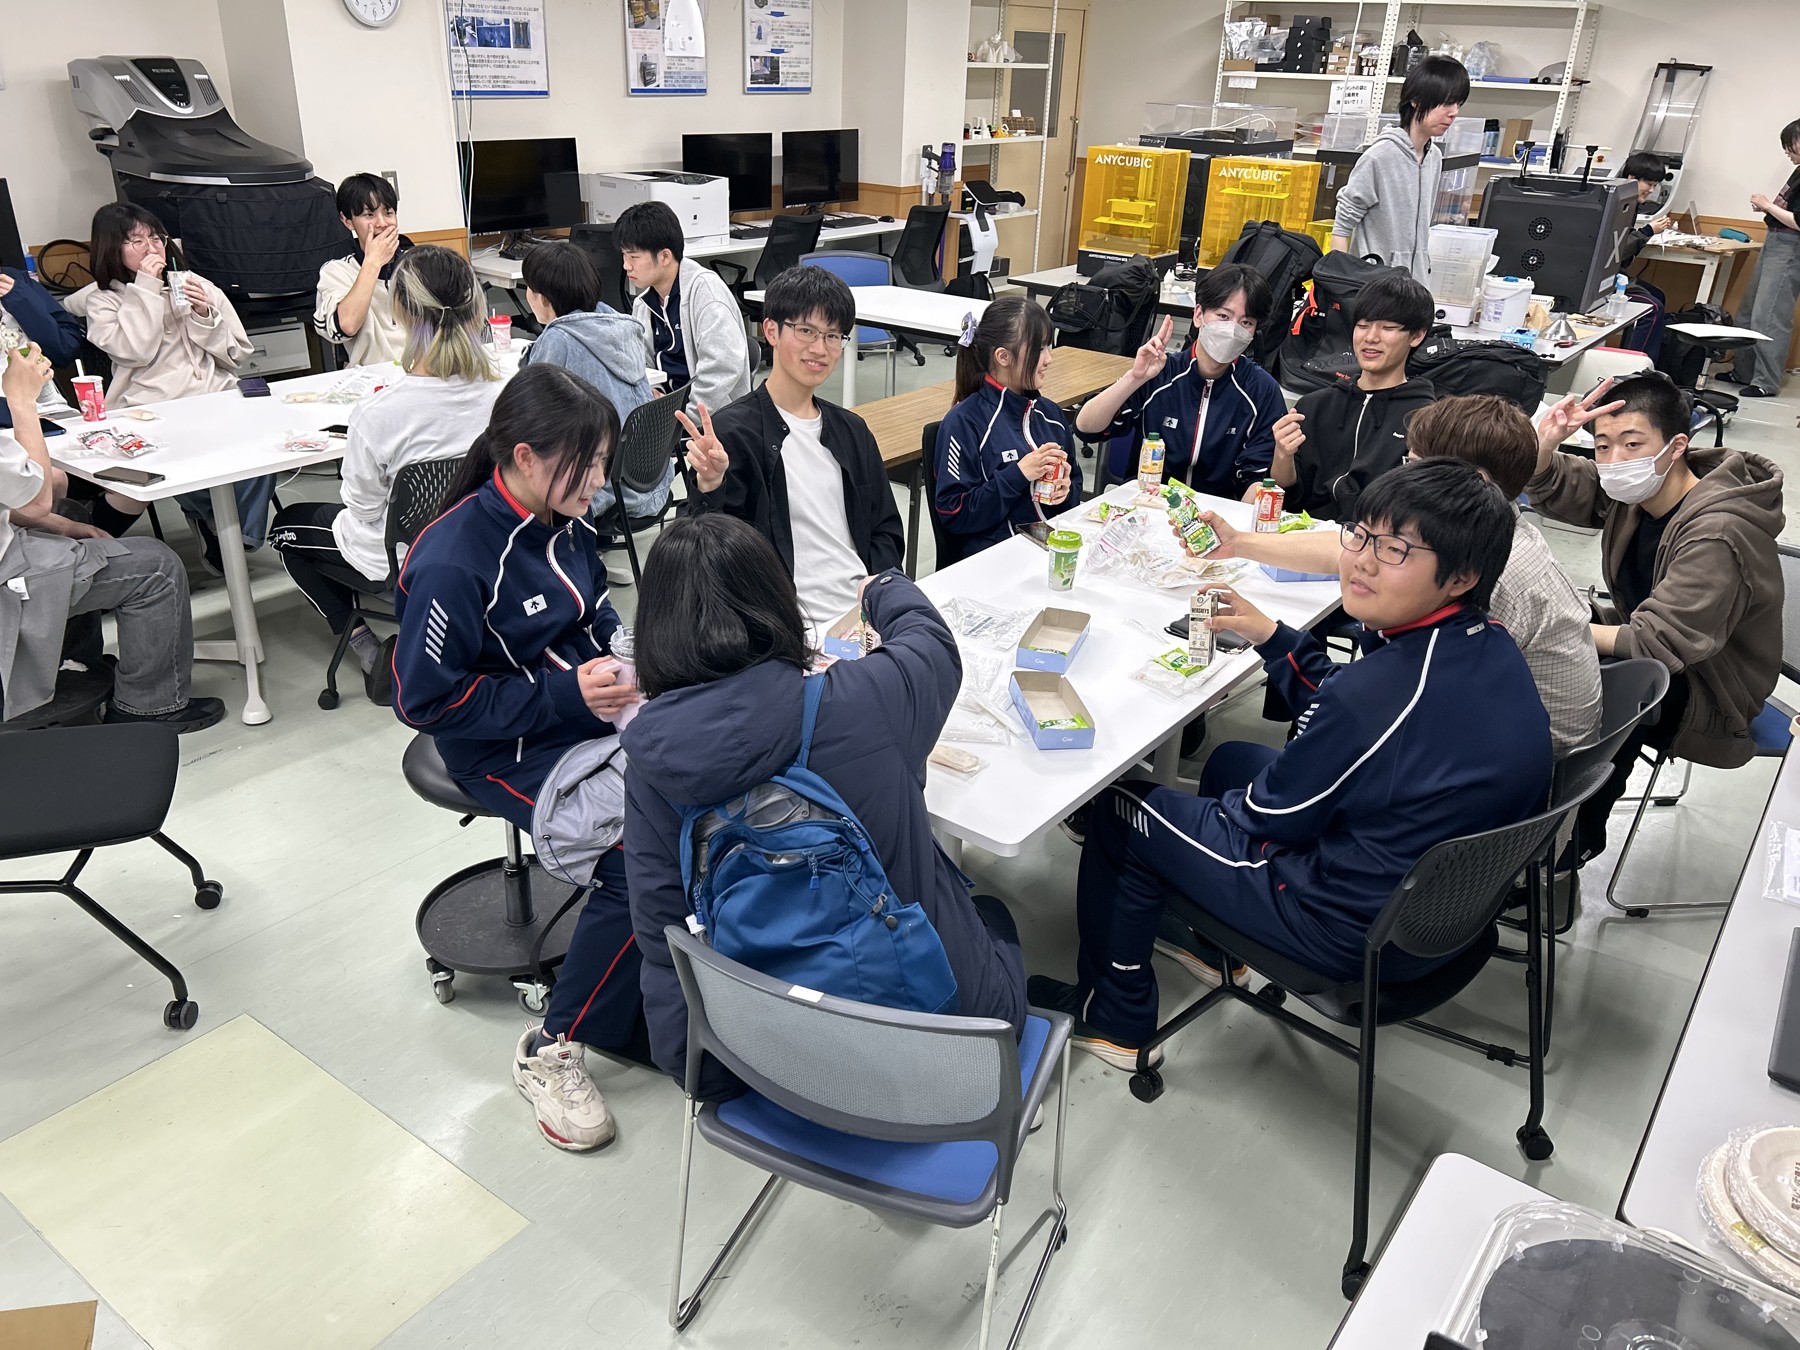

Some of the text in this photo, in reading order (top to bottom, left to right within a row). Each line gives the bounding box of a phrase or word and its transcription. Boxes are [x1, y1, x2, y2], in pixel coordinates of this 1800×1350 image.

[1095, 154, 1152, 168] ANYCUBIC
[1219, 167, 1283, 182] ANYCUBIC
[533, 1075, 547, 1089] FILA
